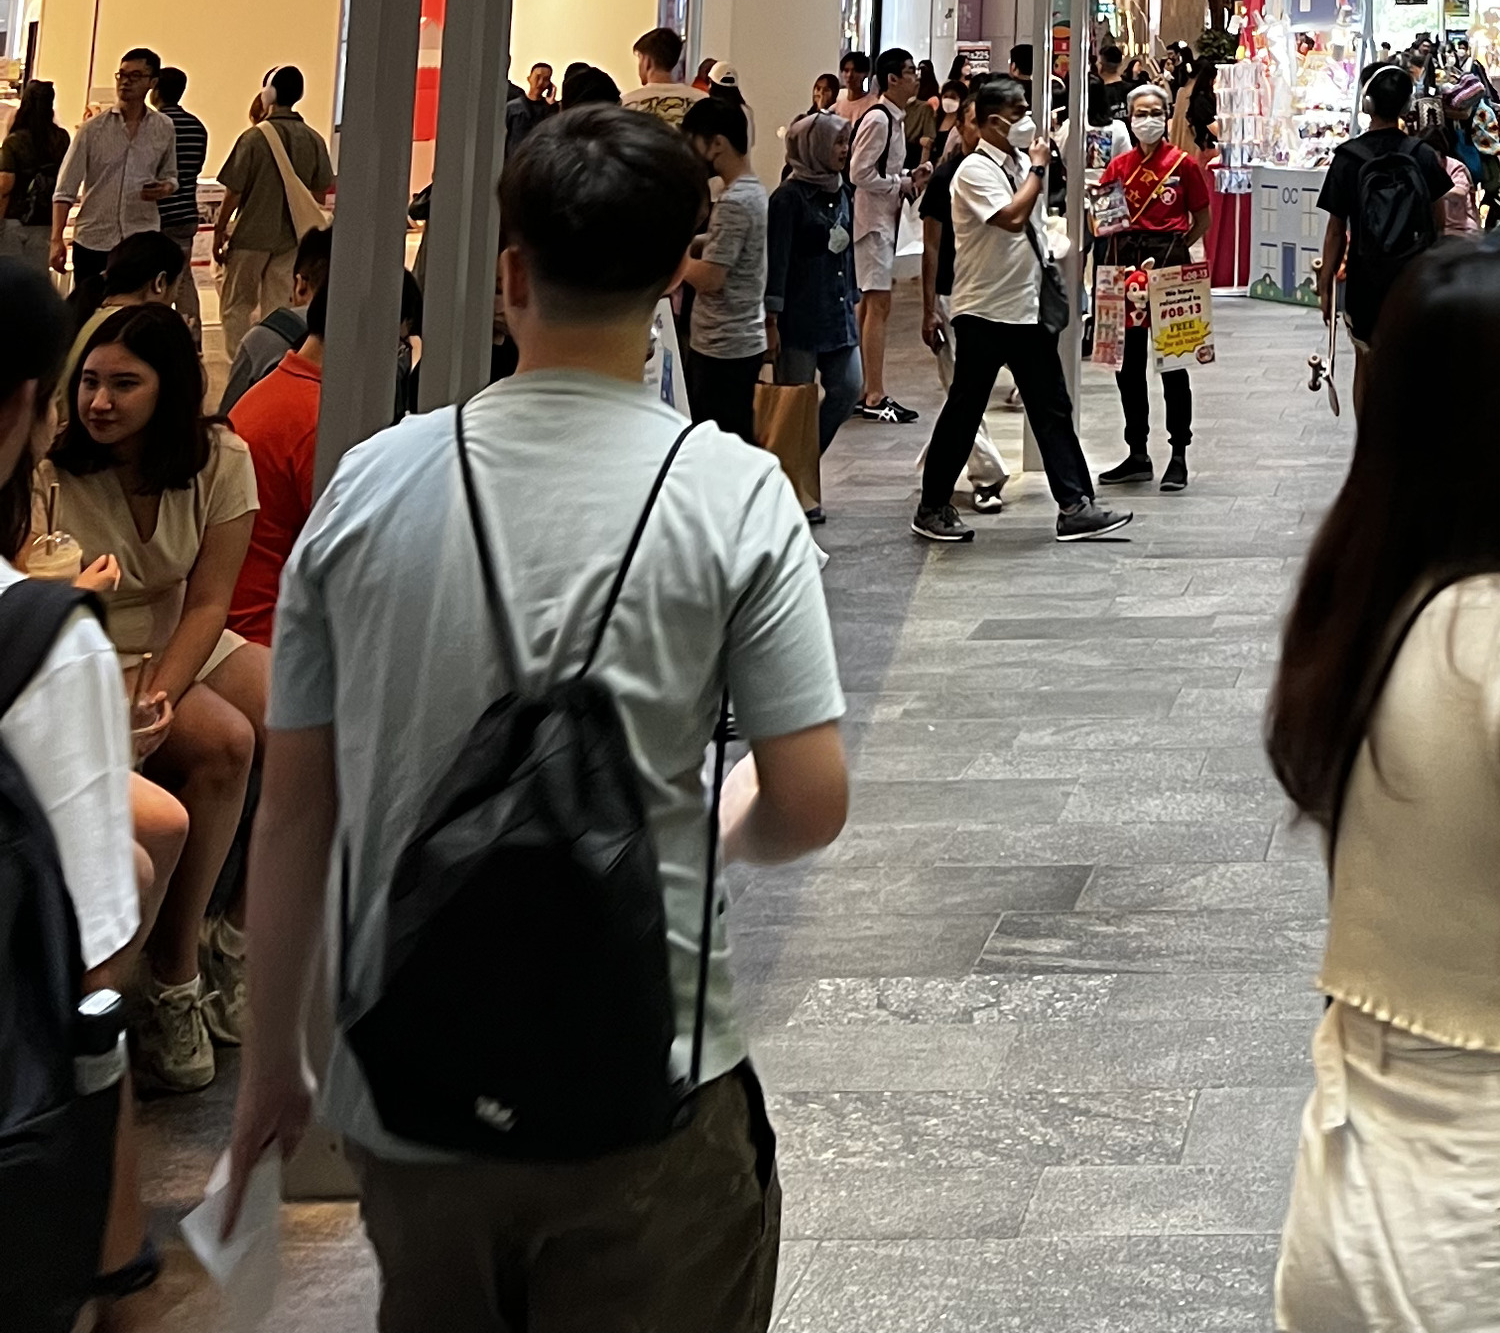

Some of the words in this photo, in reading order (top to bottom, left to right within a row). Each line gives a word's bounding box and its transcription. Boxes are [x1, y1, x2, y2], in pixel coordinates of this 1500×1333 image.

[1282, 187, 1298, 204] OC
[1161, 303, 1202, 321] #08-13
[1170, 320, 1195, 333] FREE
